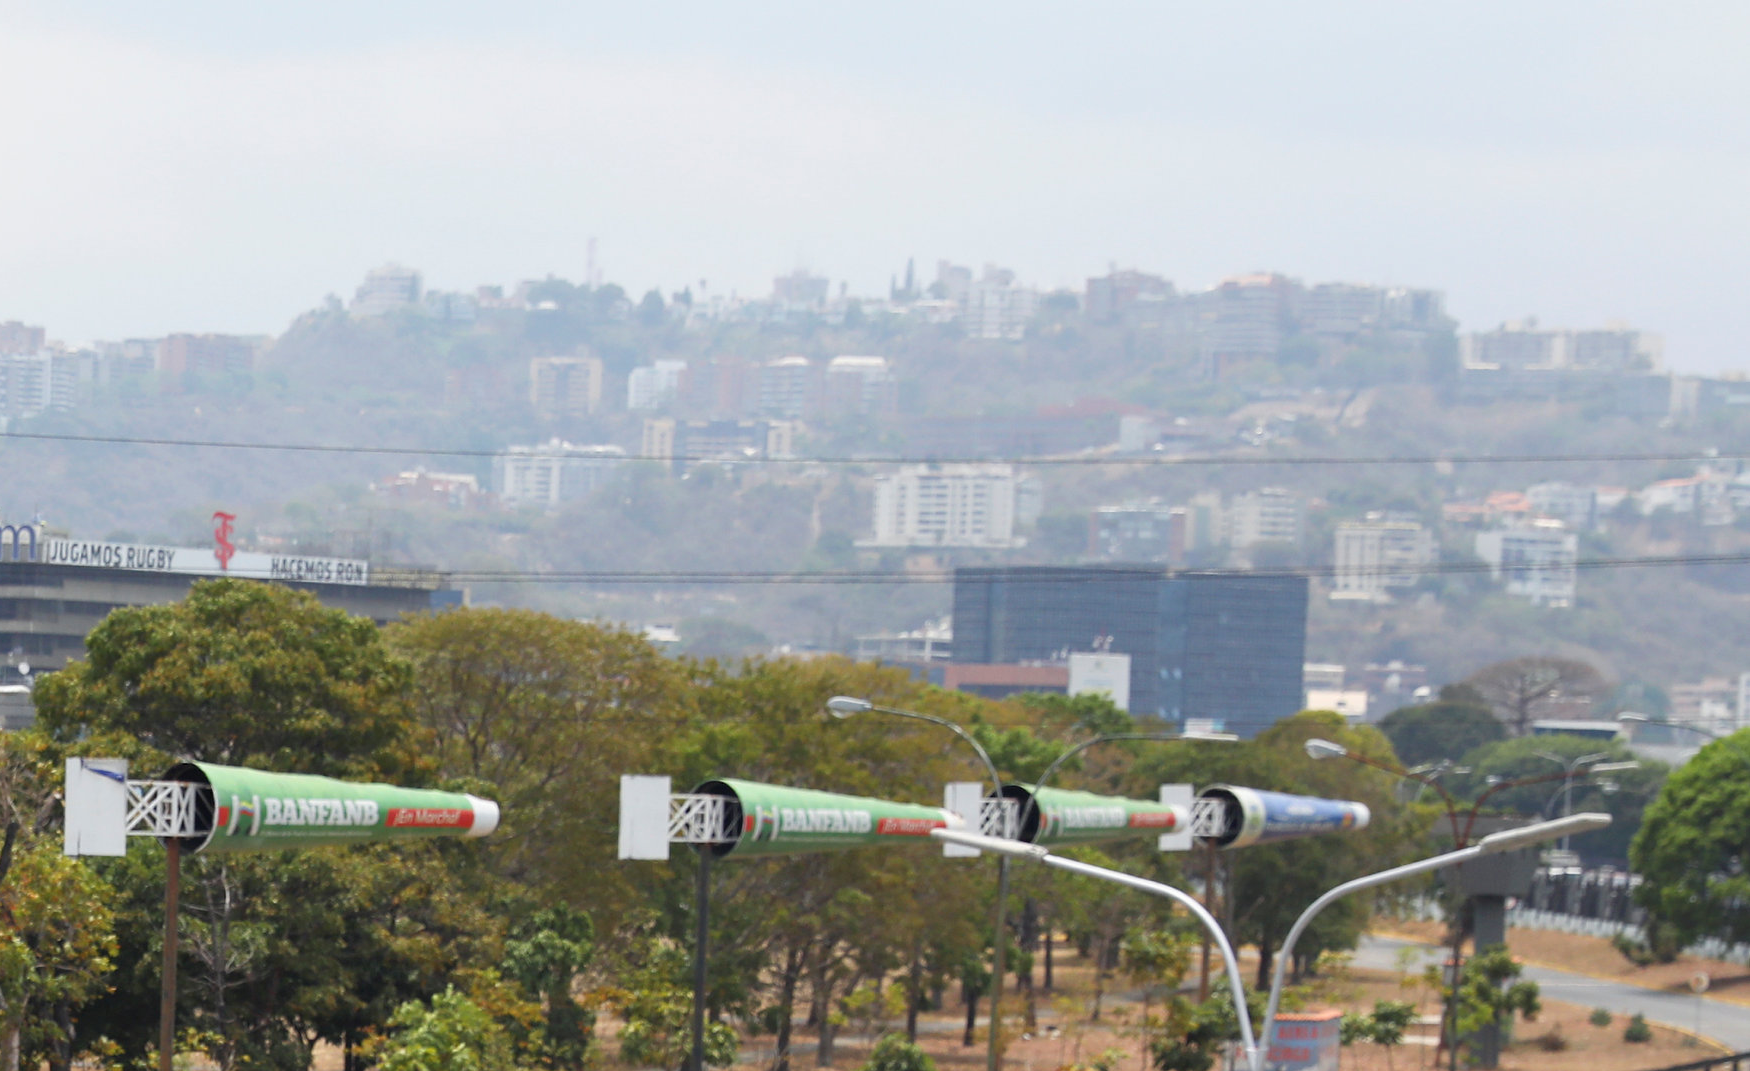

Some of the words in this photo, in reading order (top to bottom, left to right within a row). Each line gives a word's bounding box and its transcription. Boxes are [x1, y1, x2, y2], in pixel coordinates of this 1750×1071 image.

[50, 539, 122, 567] JUGAMOS
[126, 546, 176, 570] RUGBY
[271, 557, 332, 581] HACEMOS
[337, 562, 364, 582] RON
[264, 797, 380, 827] BANFANB
